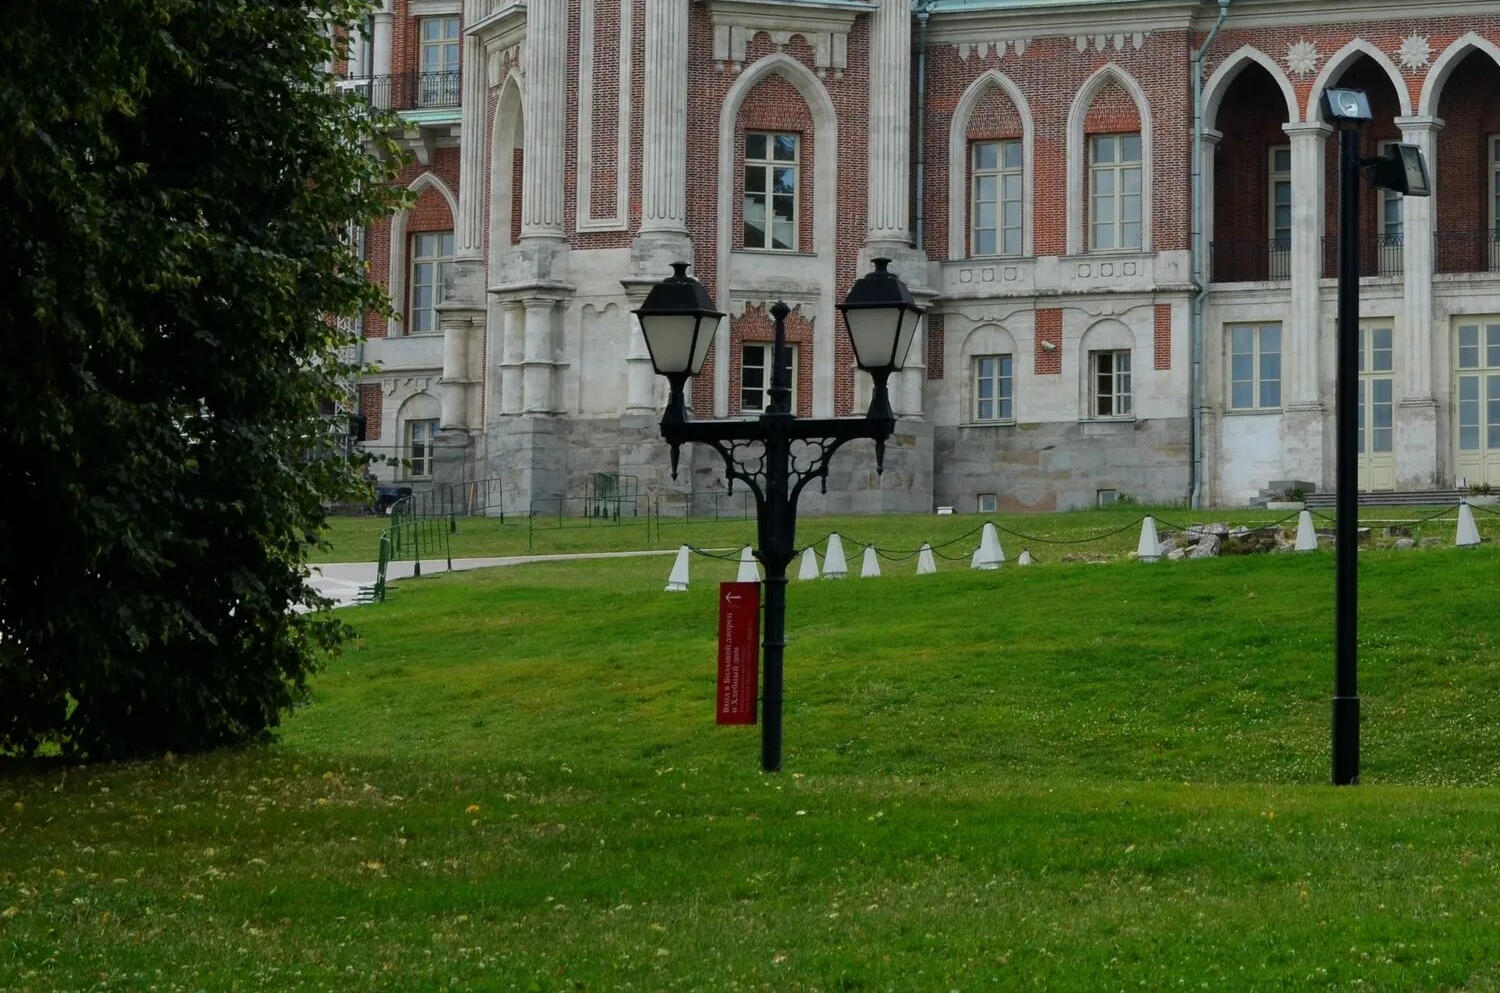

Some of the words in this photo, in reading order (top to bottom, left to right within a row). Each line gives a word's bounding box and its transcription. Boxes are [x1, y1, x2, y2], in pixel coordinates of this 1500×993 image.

[726, 612, 734, 643] дворец
[723, 644, 731, 684] Большой
[731, 666, 739, 705] Хлебный
